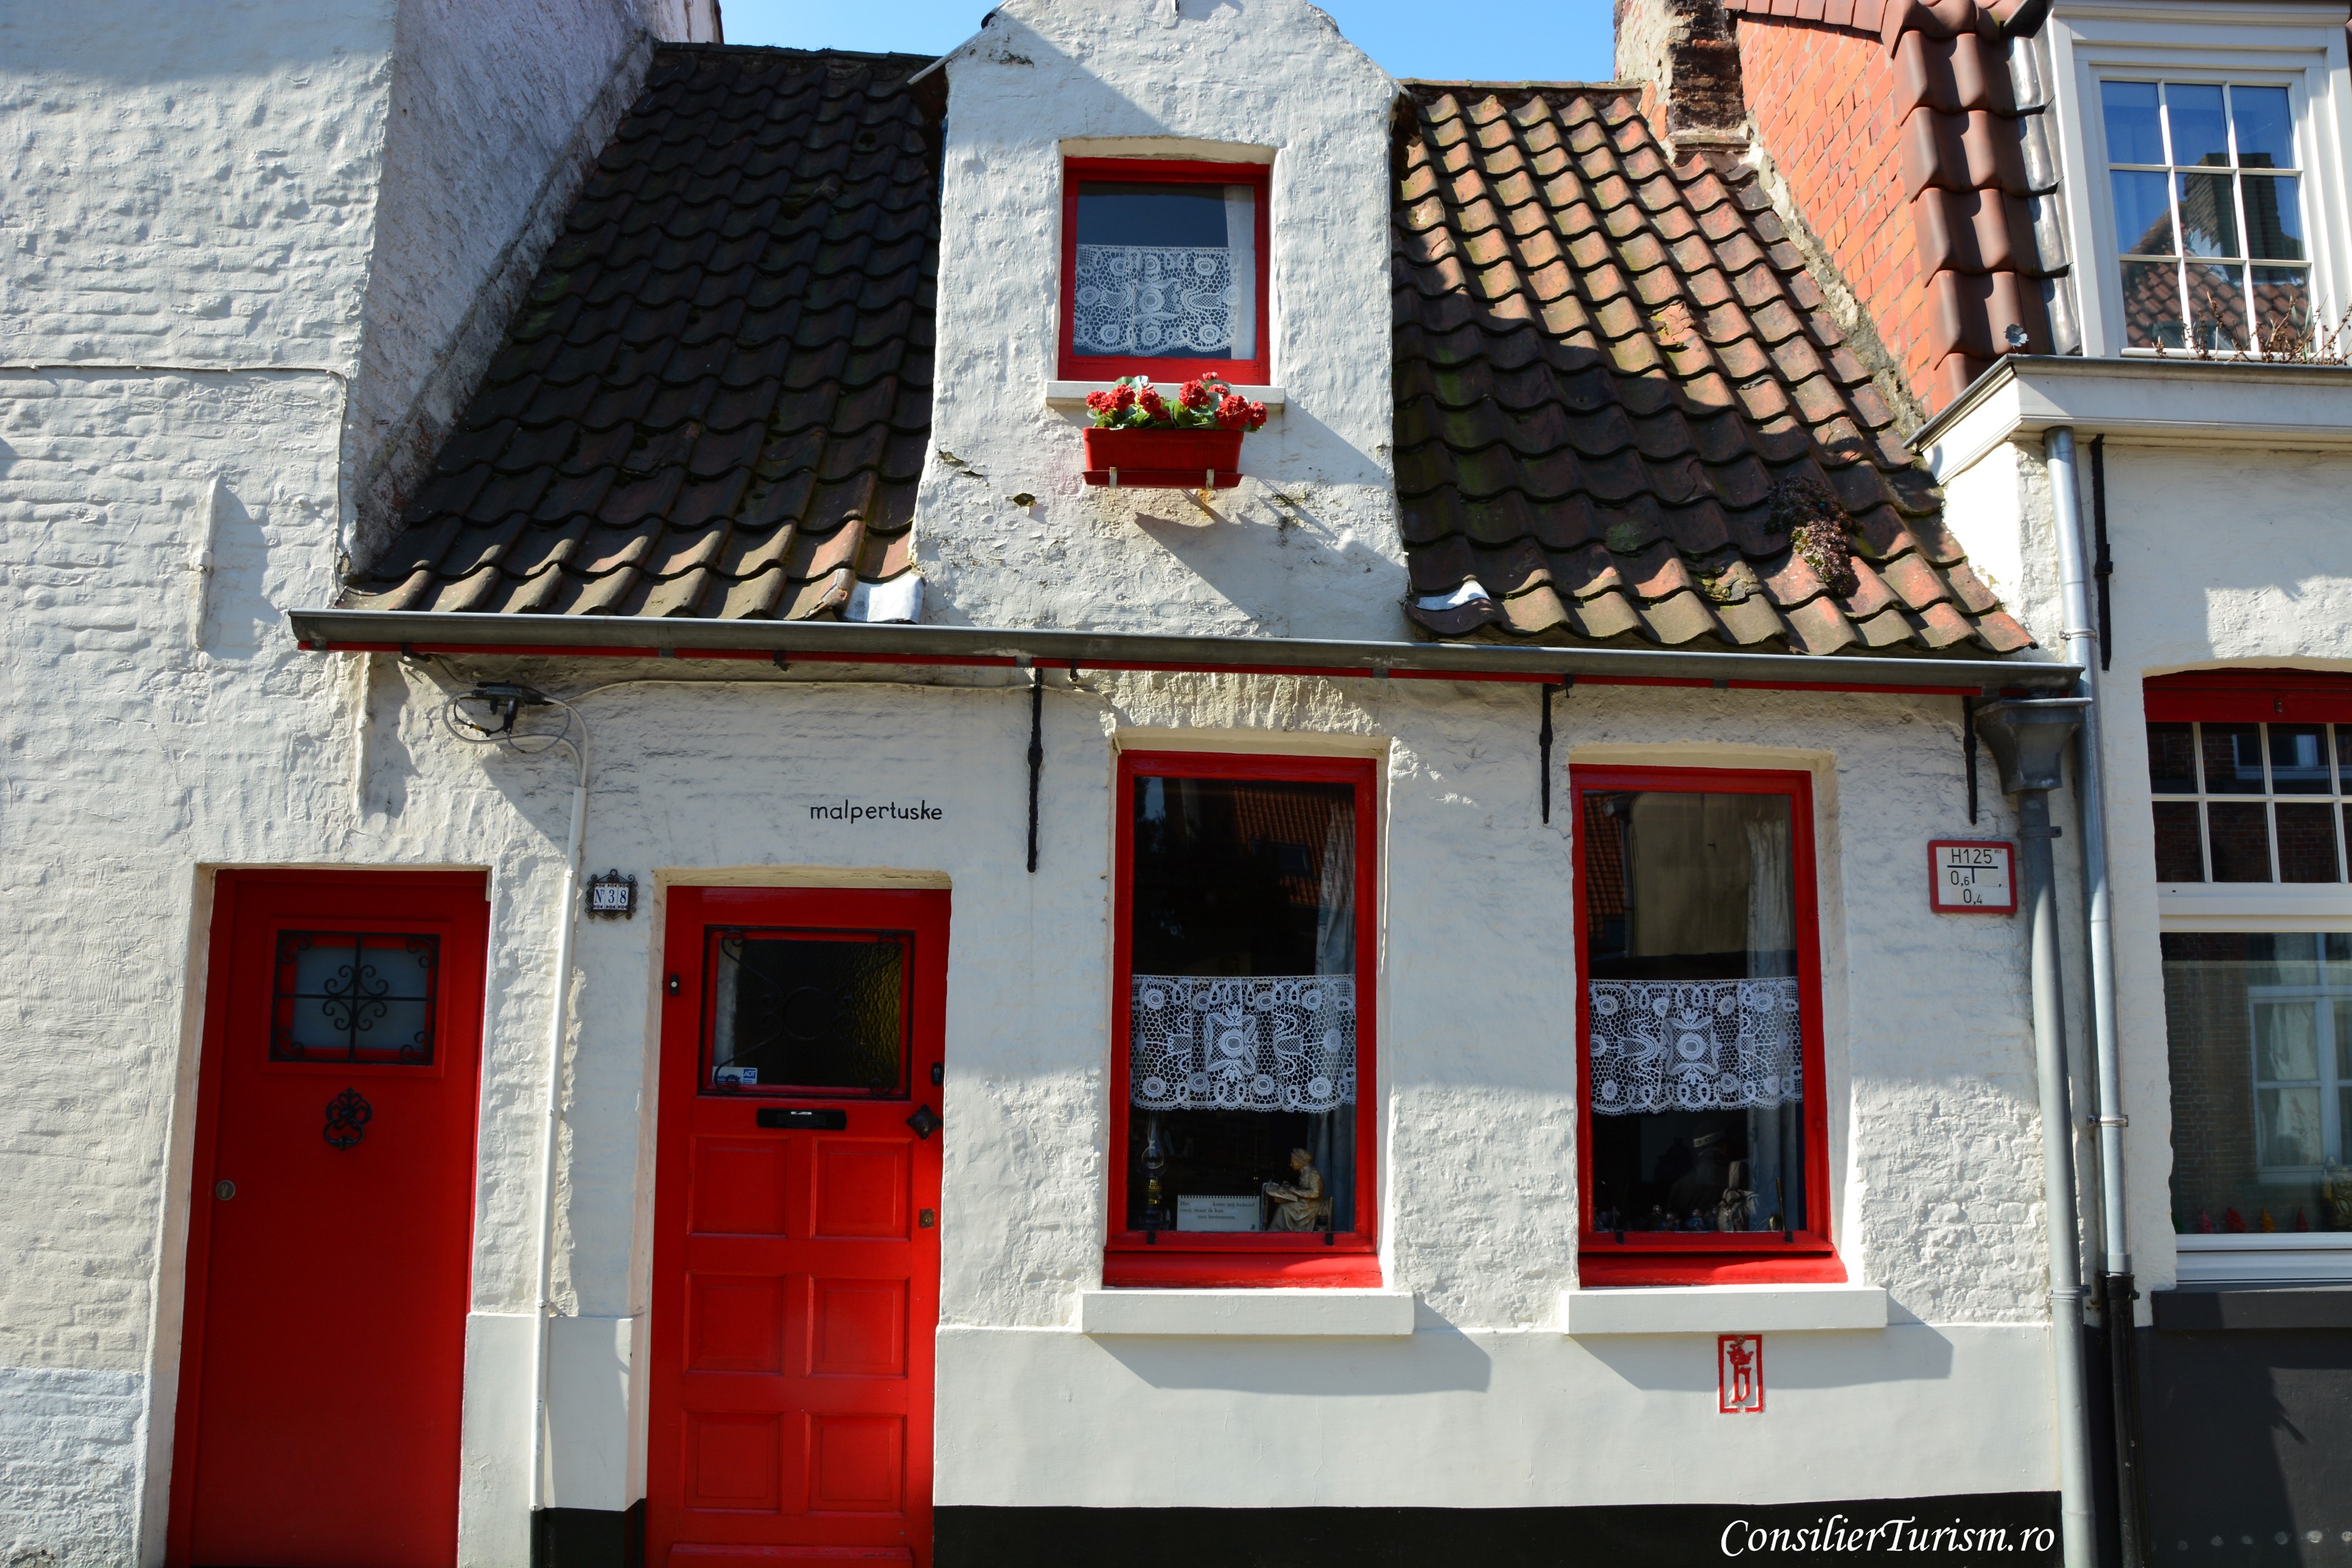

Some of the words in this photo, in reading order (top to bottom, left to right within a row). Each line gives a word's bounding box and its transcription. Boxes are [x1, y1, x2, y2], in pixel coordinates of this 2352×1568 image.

[809, 798, 943, 824] malpertuske
[1951, 848, 1992, 864] H125
[1950, 870, 1970, 886] 0,6
[1963, 889, 1982, 905] 0,4
